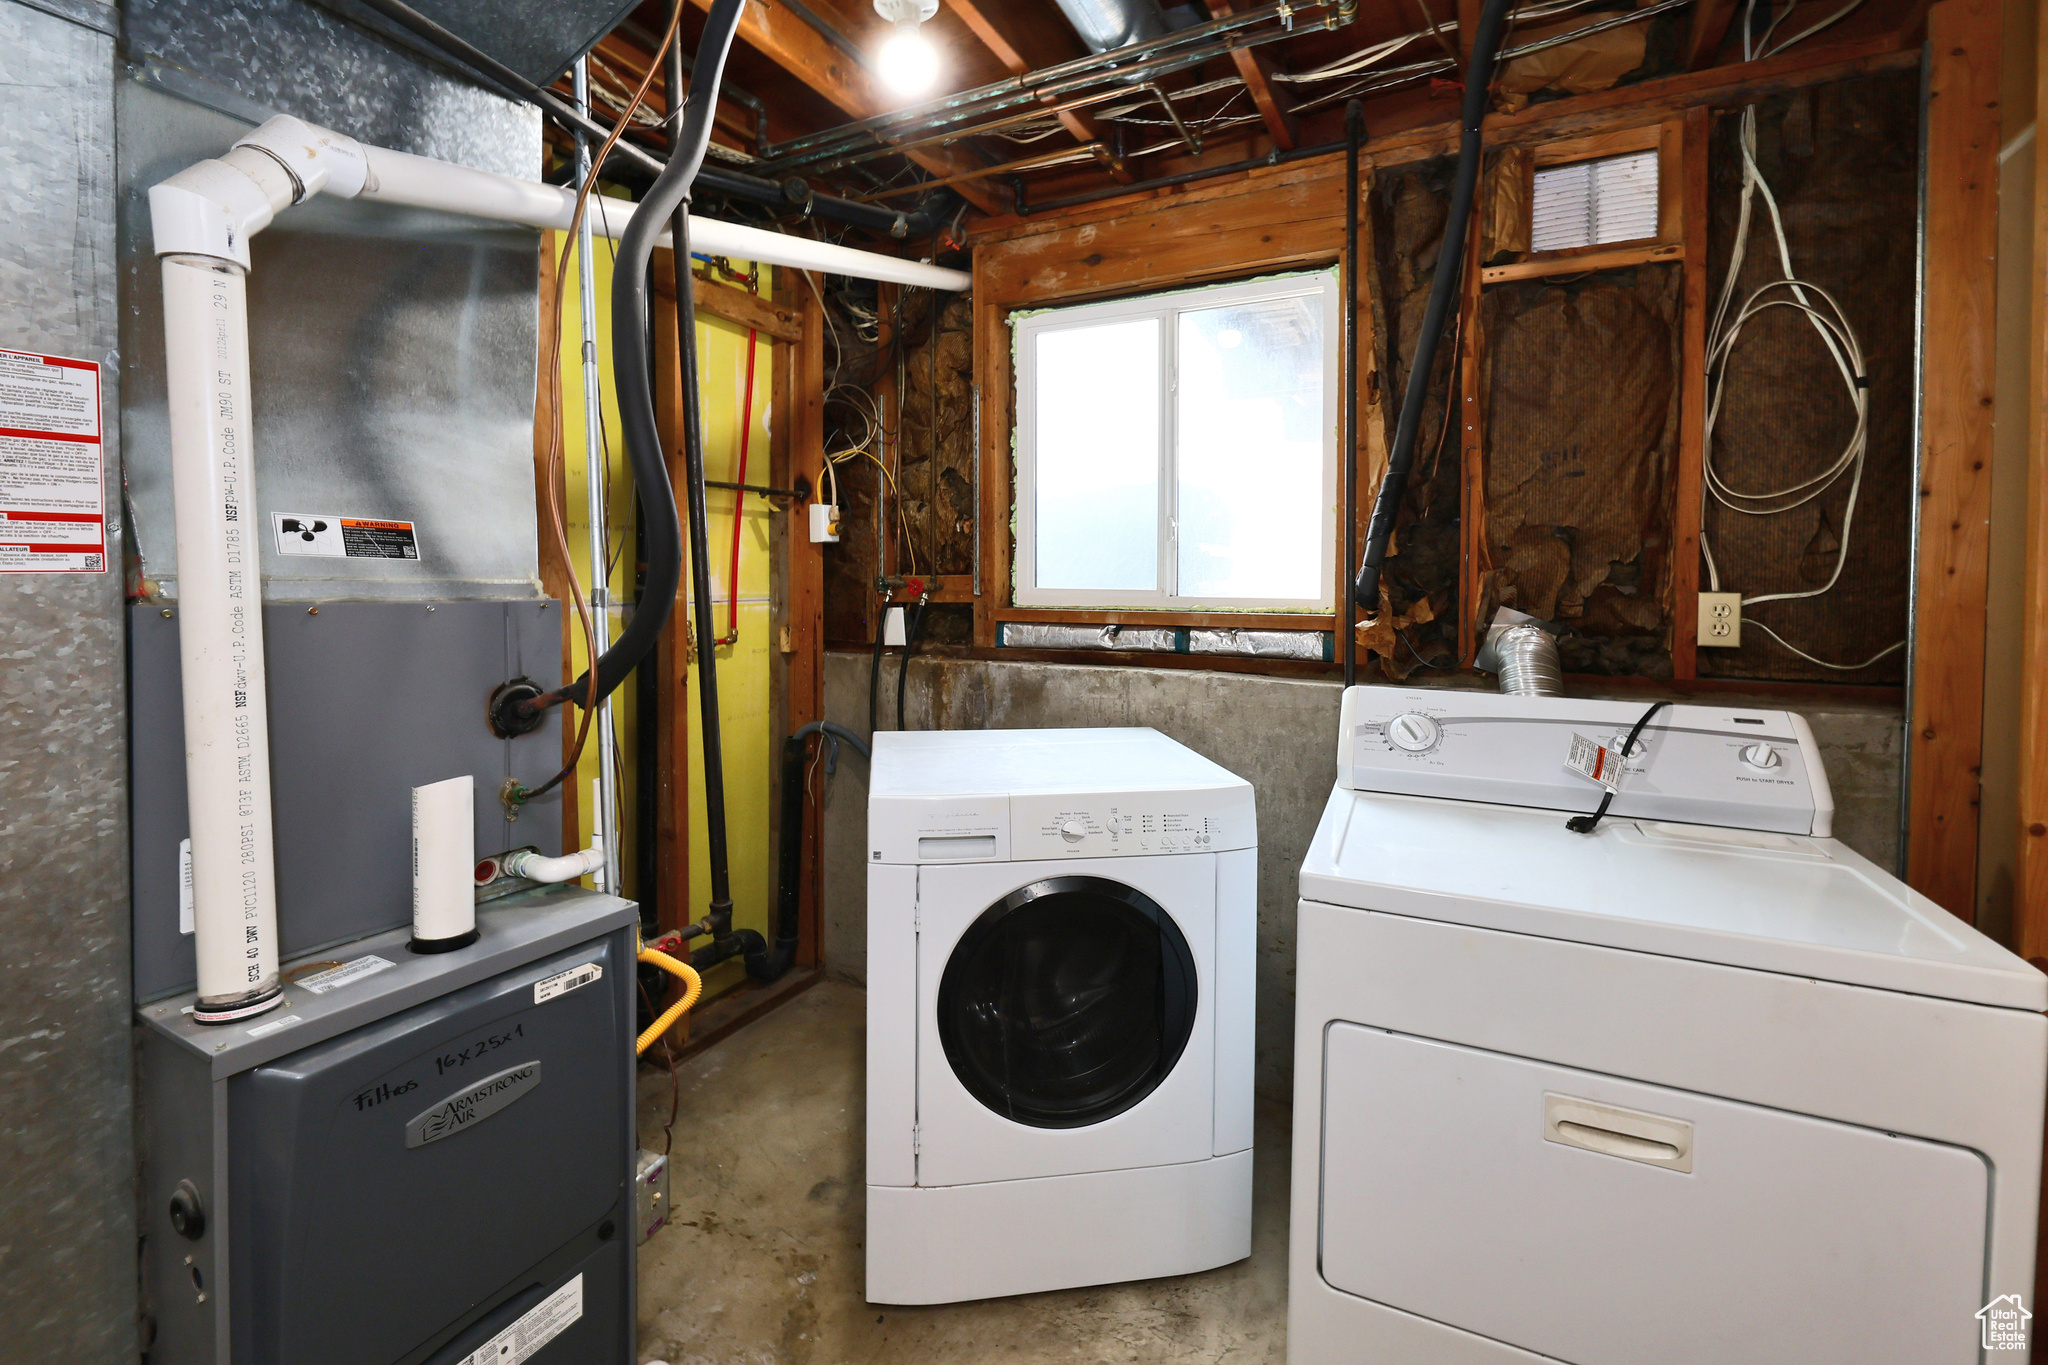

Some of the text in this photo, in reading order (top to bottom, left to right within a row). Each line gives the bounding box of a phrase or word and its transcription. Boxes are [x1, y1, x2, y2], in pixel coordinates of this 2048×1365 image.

[214, 280, 226, 288] N
[214, 294, 227, 309] 29
[218, 370, 232, 385] ST
[218, 392, 233, 420] JM90
[362, 520, 400, 529] WARNING
[226, 528, 240, 562] D1785
[230, 571, 242, 598] ASTM
[235, 715, 250, 748] D2665
[238, 755, 252, 782] ASTM
[240, 823, 254, 864] 280PSI
[242, 871, 258, 918] PVC1120
[246, 925, 258, 942] DWV
[246, 948, 260, 958] 40
[246, 963, 260, 982] SCH
[442, 1066, 533, 1119] ARMSTRONG
[448, 1108, 476, 1130] AIR
